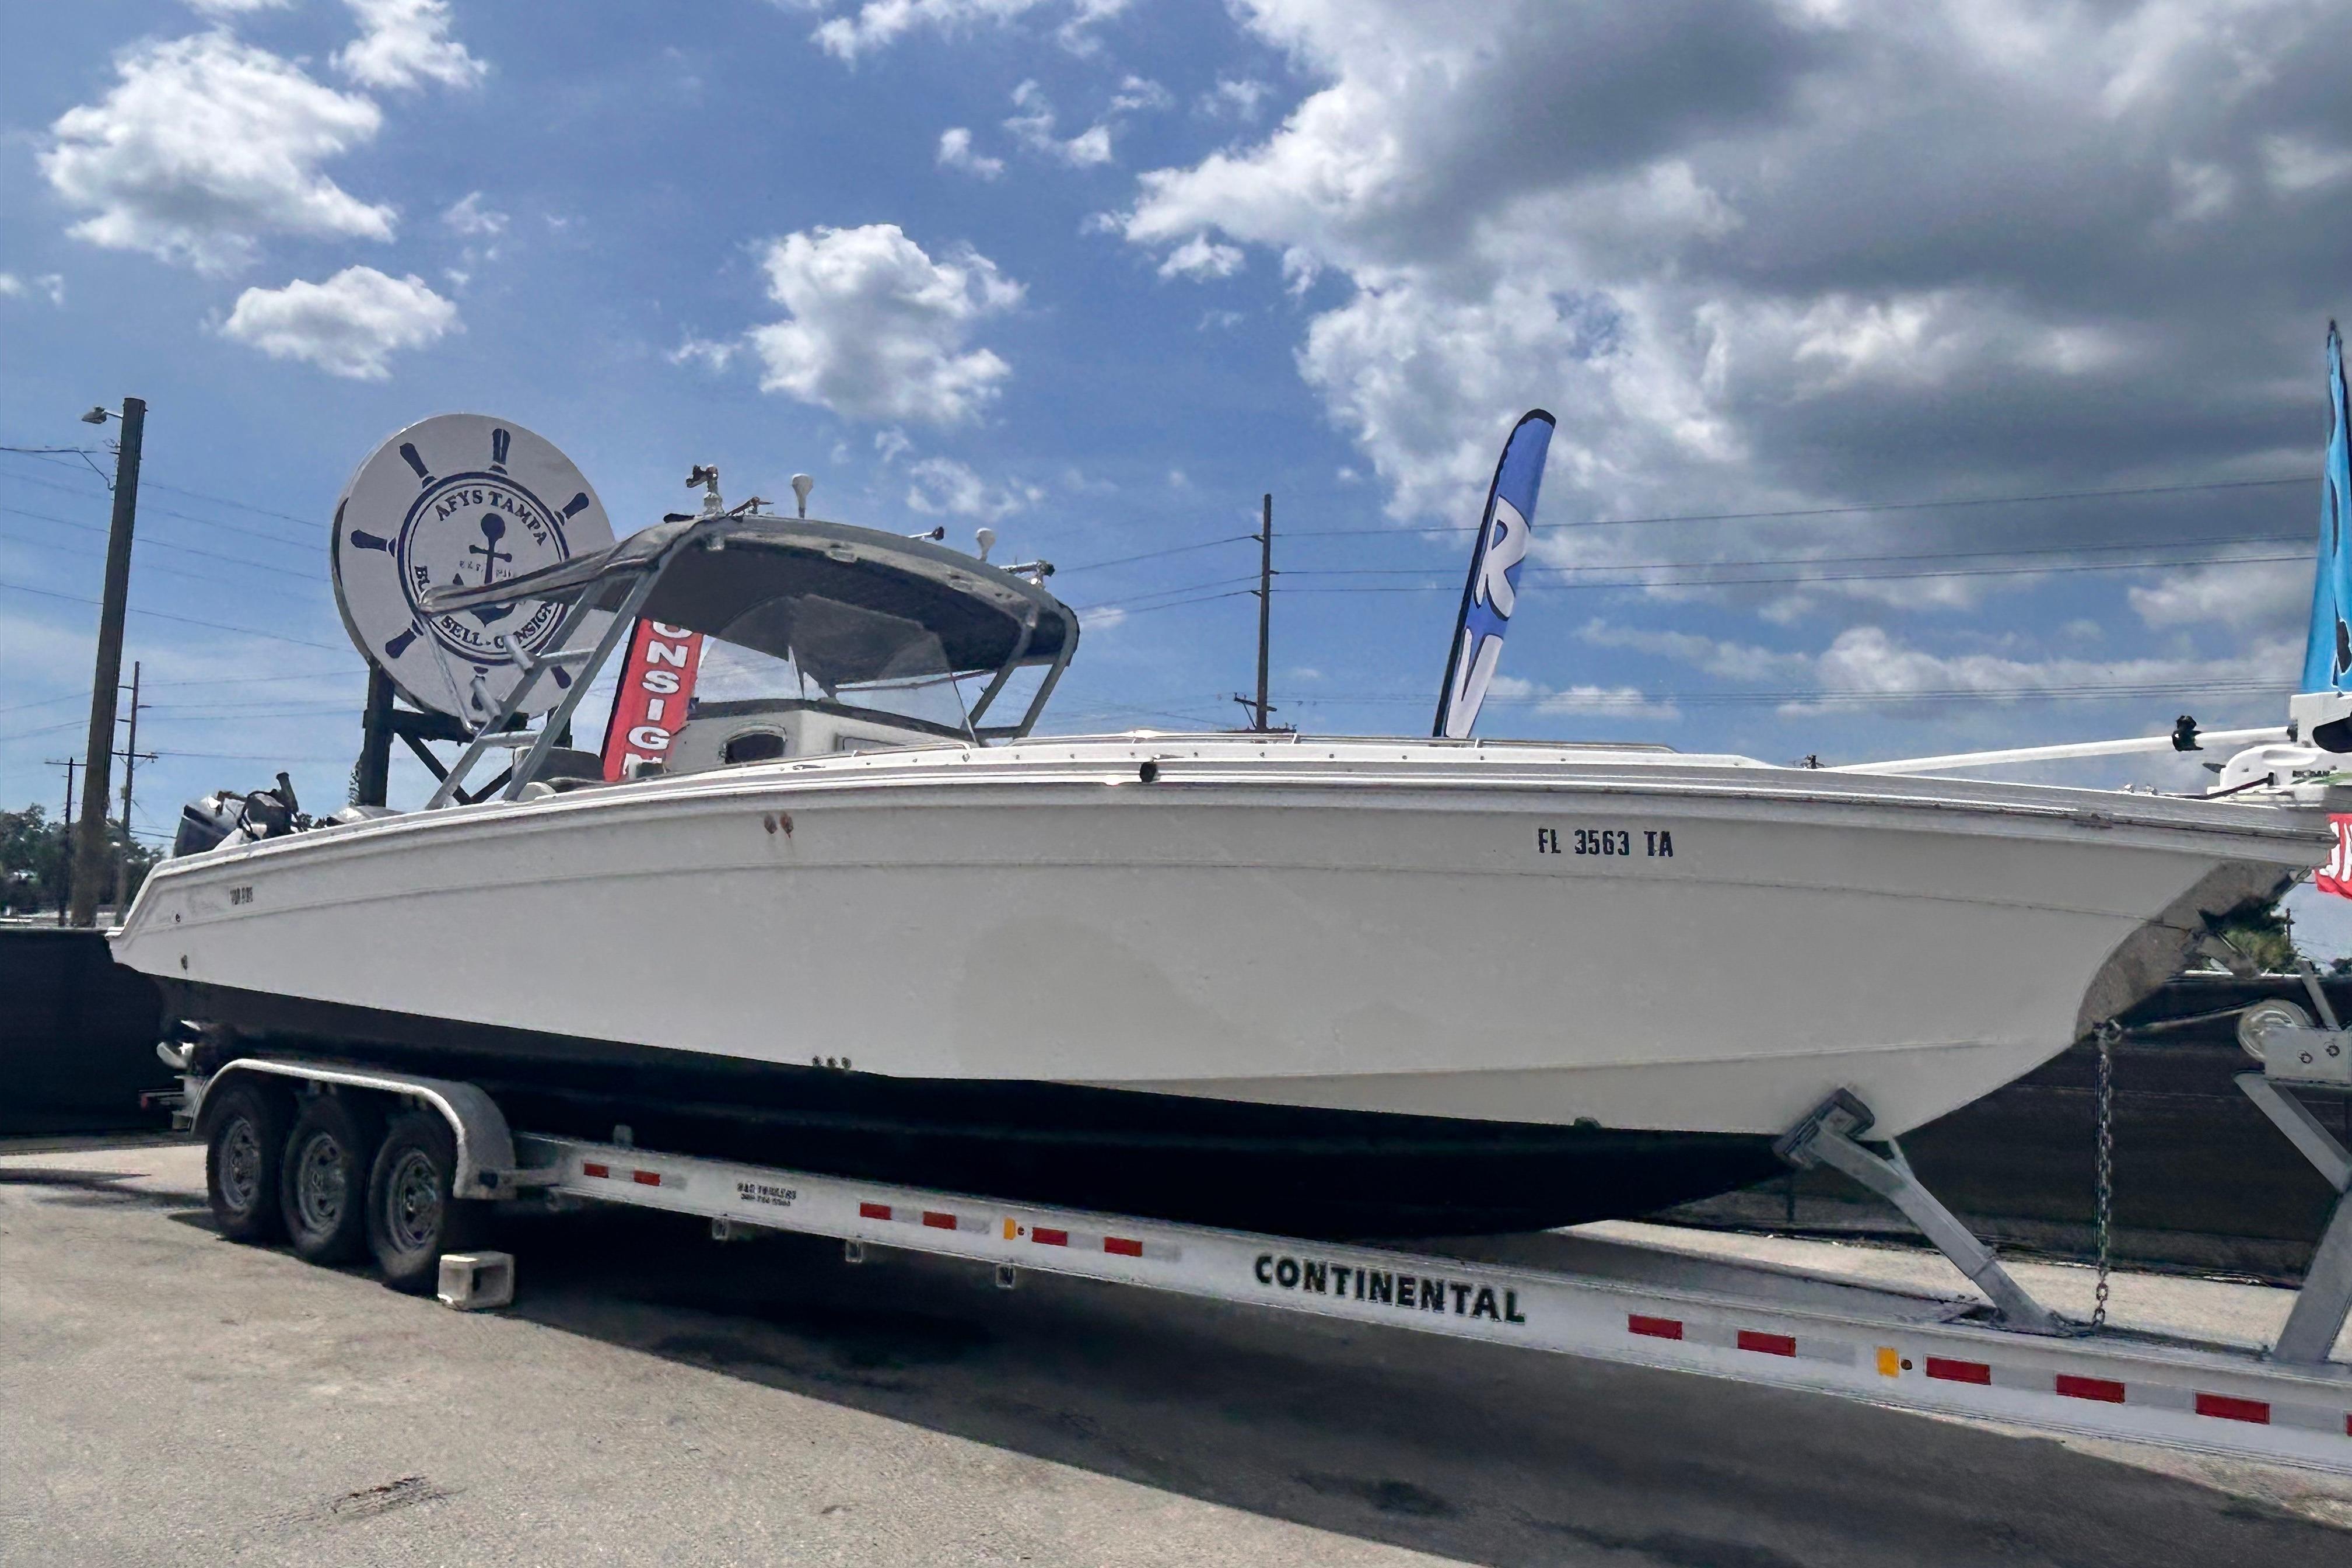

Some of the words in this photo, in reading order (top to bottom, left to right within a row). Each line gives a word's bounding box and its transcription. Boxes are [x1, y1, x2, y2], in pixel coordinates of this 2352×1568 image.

[488, 490, 547, 547] TAMPA
[441, 615, 483, 646] SELL
[494, 602, 552, 649] CNSIG
[1538, 828, 1562, 854] FL
[1574, 828, 1630, 856] 3563
[1643, 830, 1674, 858] TA
[1254, 1252, 1526, 1324] CONTINENTAL
